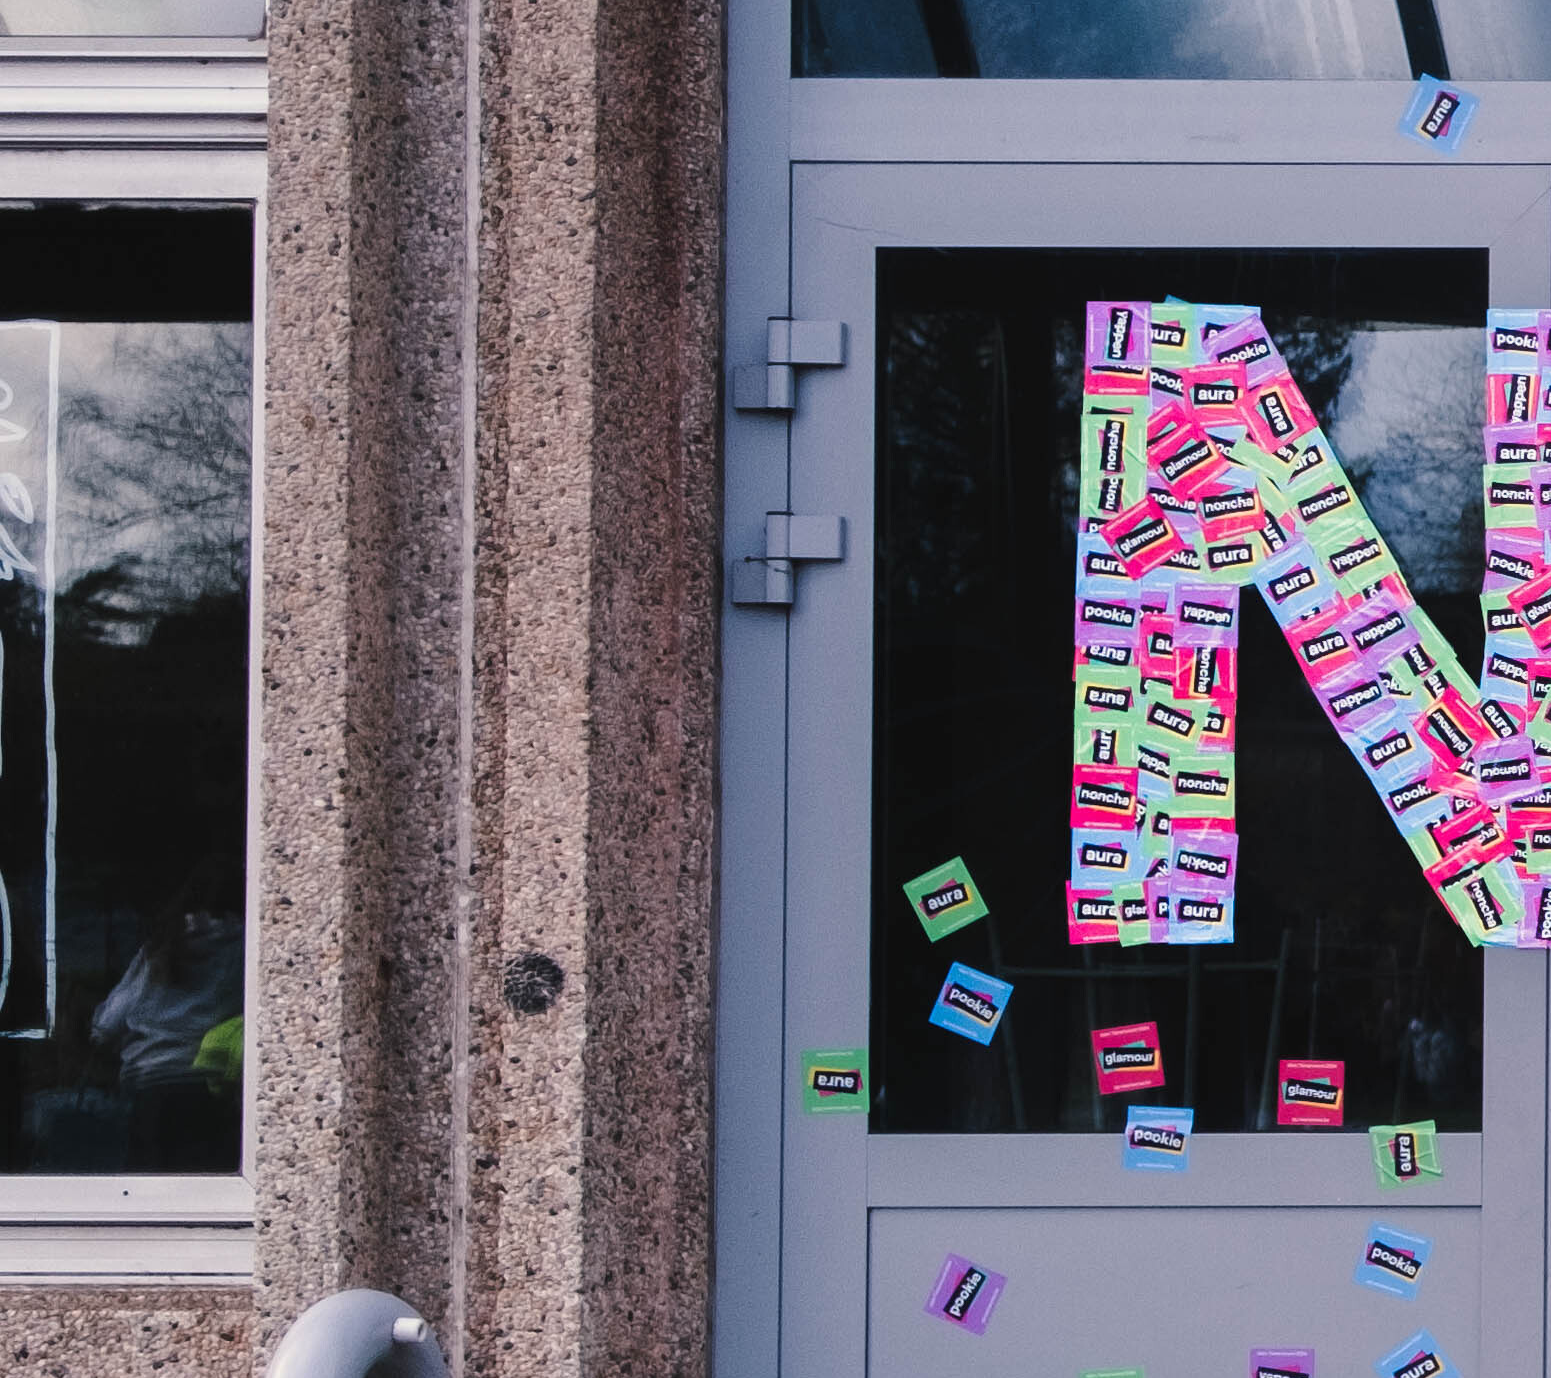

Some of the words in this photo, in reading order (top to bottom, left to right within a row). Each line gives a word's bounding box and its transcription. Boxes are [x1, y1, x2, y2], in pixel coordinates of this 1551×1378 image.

[1426, 98, 1452, 132] aura
[1198, 389, 1235, 401] aura
[1266, 396, 1287, 431] aura
[1107, 422, 1121, 470] noncha
[1165, 445, 1208, 477] glamour
[1120, 524, 1164, 553] glamour
[1085, 606, 1132, 623] pookie
[1154, 709, 1189, 732] aura
[1433, 712, 1468, 752] glamour
[1081, 789, 1129, 806] noncha
[1180, 854, 1227, 873] pookie
[928, 889, 963, 910] aura
[1183, 905, 1218, 918] aura
[949, 988, 993, 1024] pookie
[1105, 1052, 1153, 1065] glamour
[818, 1075, 854, 1088] aura
[1288, 1084, 1336, 1100] glamour
[1134, 1129, 1181, 1148] pookie
[1398, 1135, 1415, 1172] aura
[1371, 1247, 1416, 1275] pookie
[949, 1273, 981, 1316] pookie
